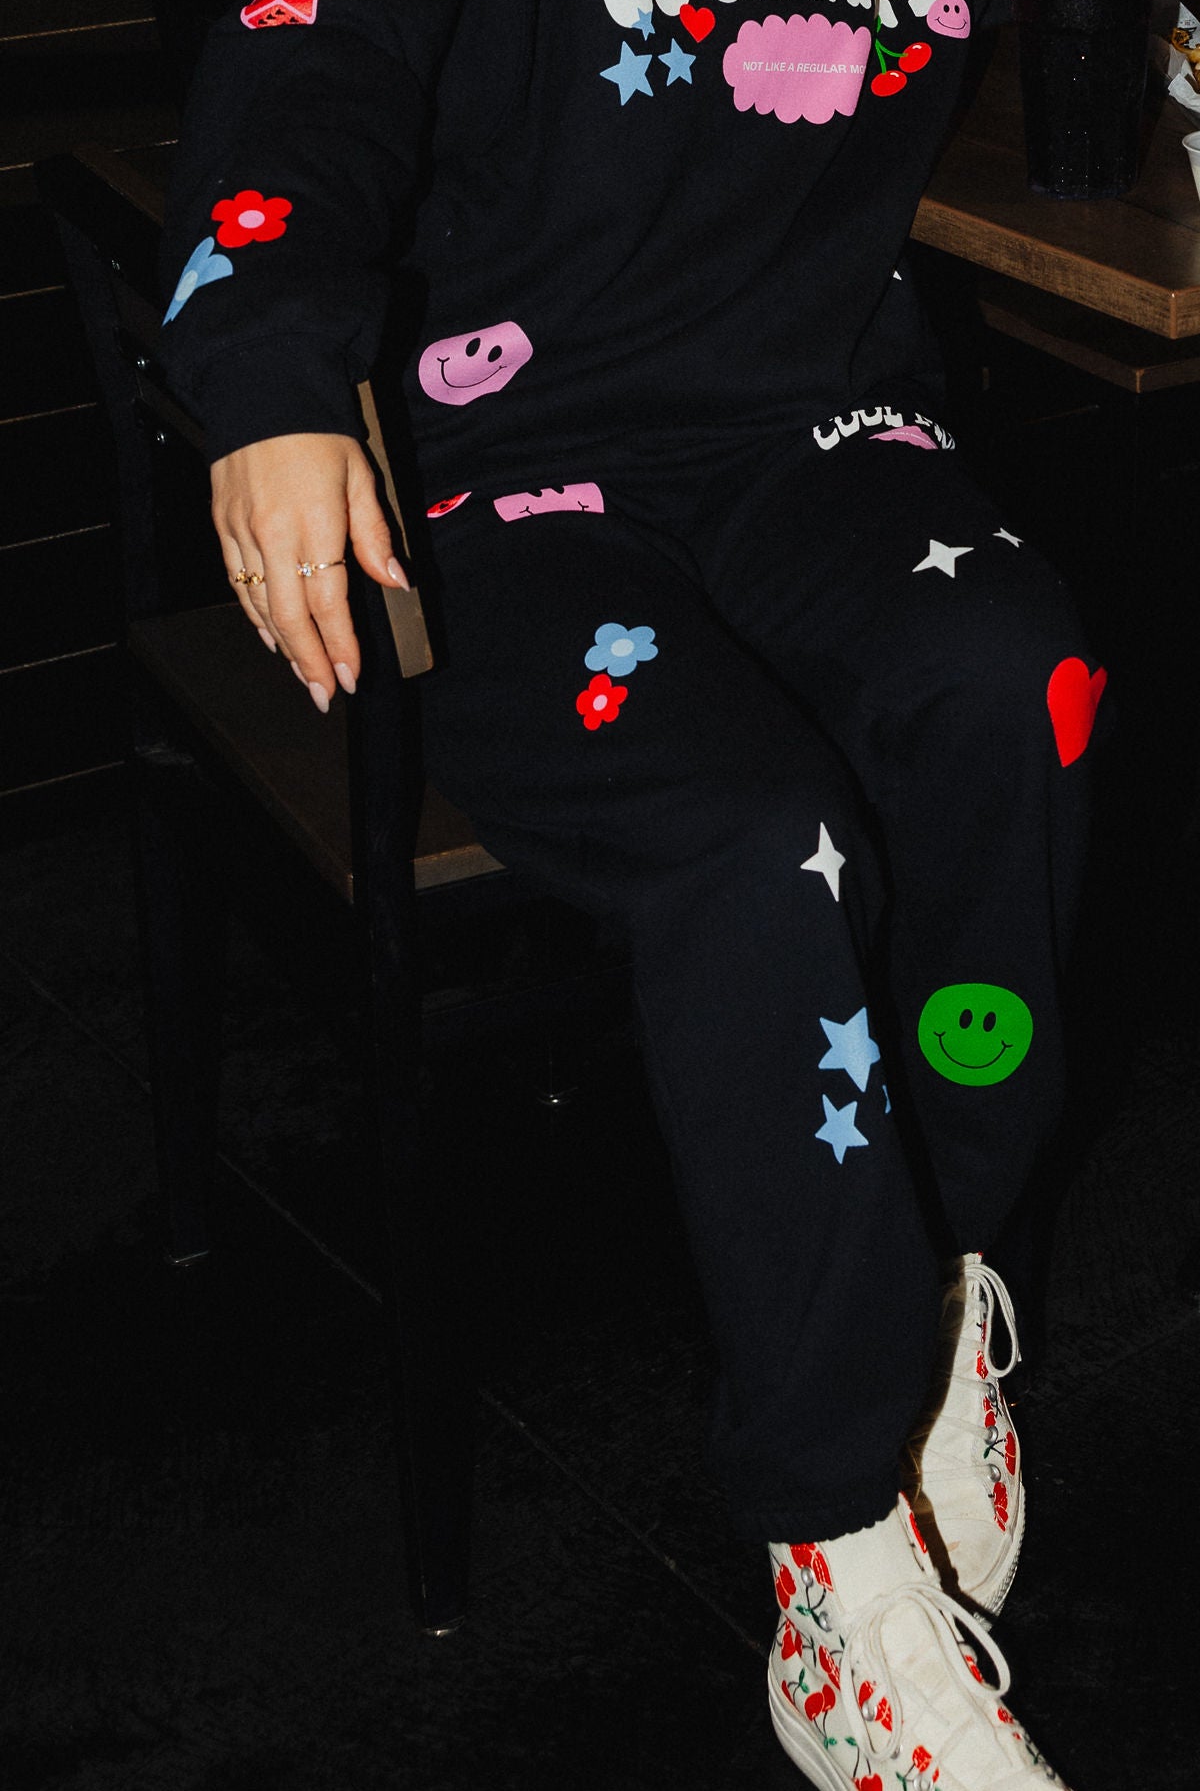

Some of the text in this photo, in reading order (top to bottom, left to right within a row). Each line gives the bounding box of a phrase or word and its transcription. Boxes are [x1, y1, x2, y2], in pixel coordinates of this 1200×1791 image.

[743, 61, 763, 71] NOT
[765, 62, 786, 72] LIKE
[787, 63, 795, 72] A
[796, 63, 847, 74] REGULAR
